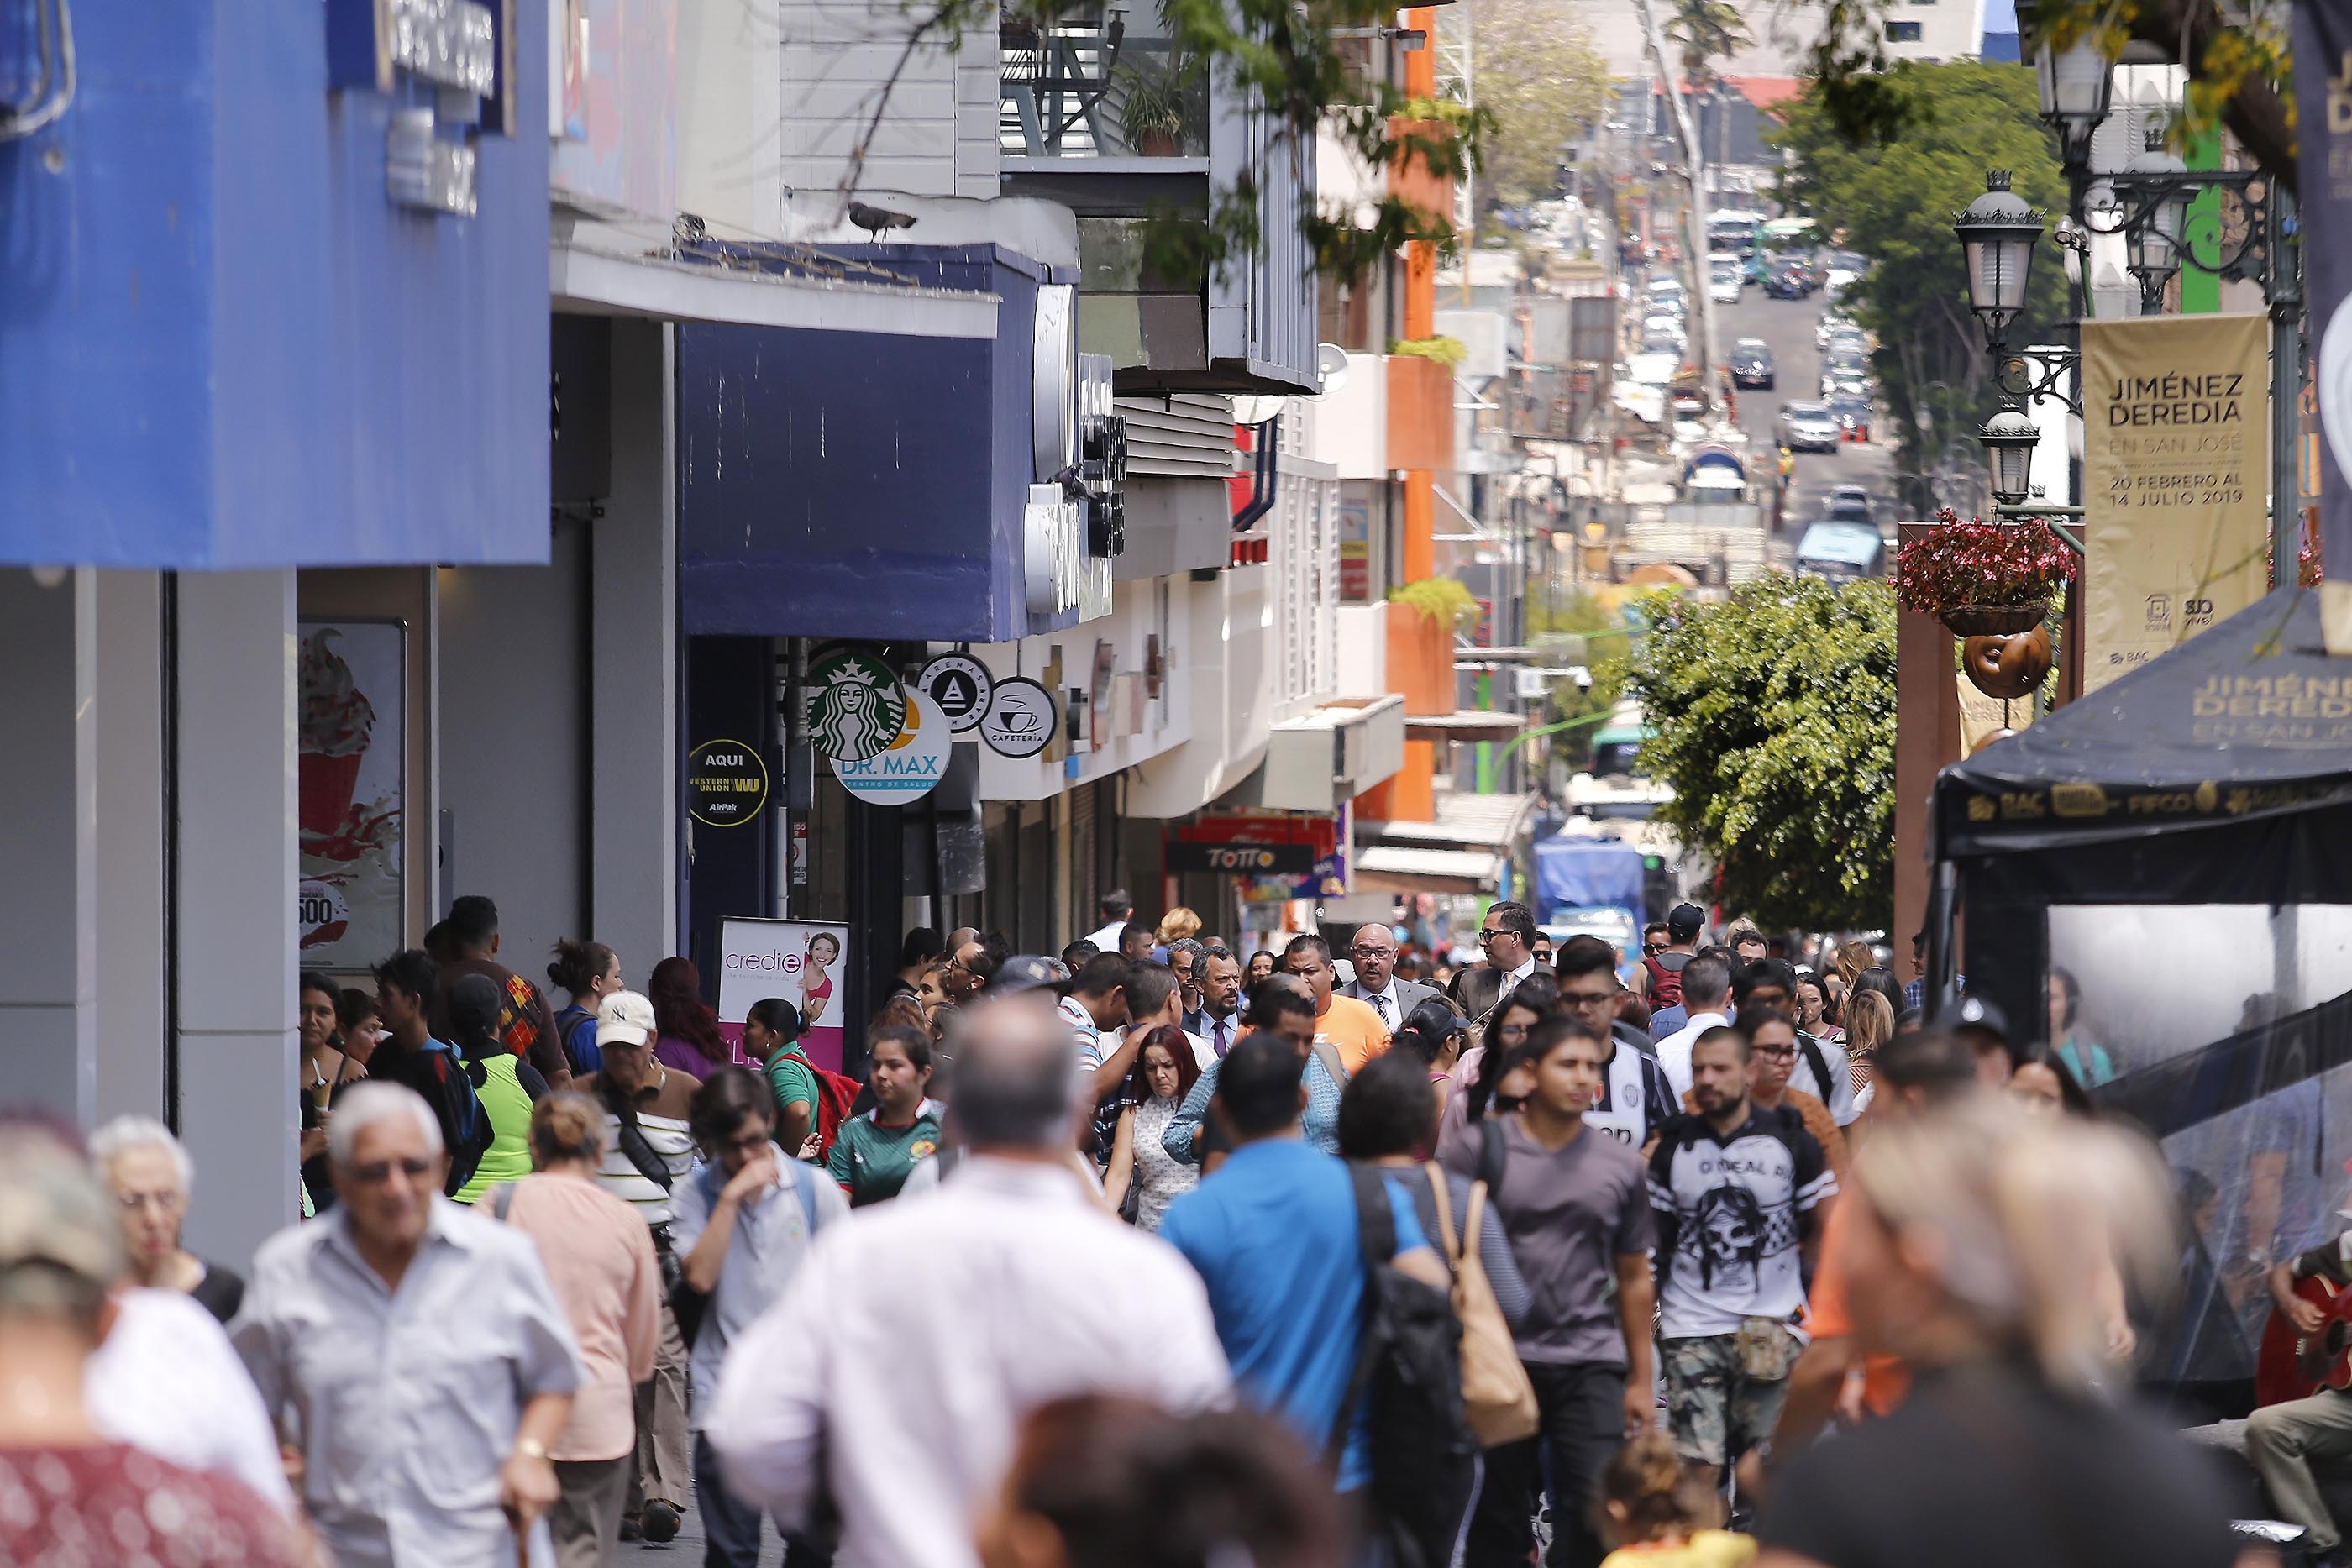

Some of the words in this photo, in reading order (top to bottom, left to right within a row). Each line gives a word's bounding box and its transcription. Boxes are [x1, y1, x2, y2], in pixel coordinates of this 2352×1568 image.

[2108, 370, 2244, 401] JIMÉNEZ
[2109, 401, 2242, 427] DEREDIA
[2109, 438, 2137, 455] EN
[2143, 437, 2185, 454] SAN
[2192, 433, 2243, 454] JOSÉ
[2110, 475, 2133, 490] 20
[2137, 473, 2218, 490] FEBRERO
[2223, 472, 2242, 487] AL
[2110, 494, 2129, 507] 14
[2137, 491, 2194, 507] JULIO
[2202, 489, 2243, 506] 2019
[706, 754, 743, 766] AQUI
[841, 758, 877, 774] DR.
[884, 755, 938, 774] MAX
[709, 803, 737, 811] AirPak
[1207, 848, 1275, 868] TOTTO
